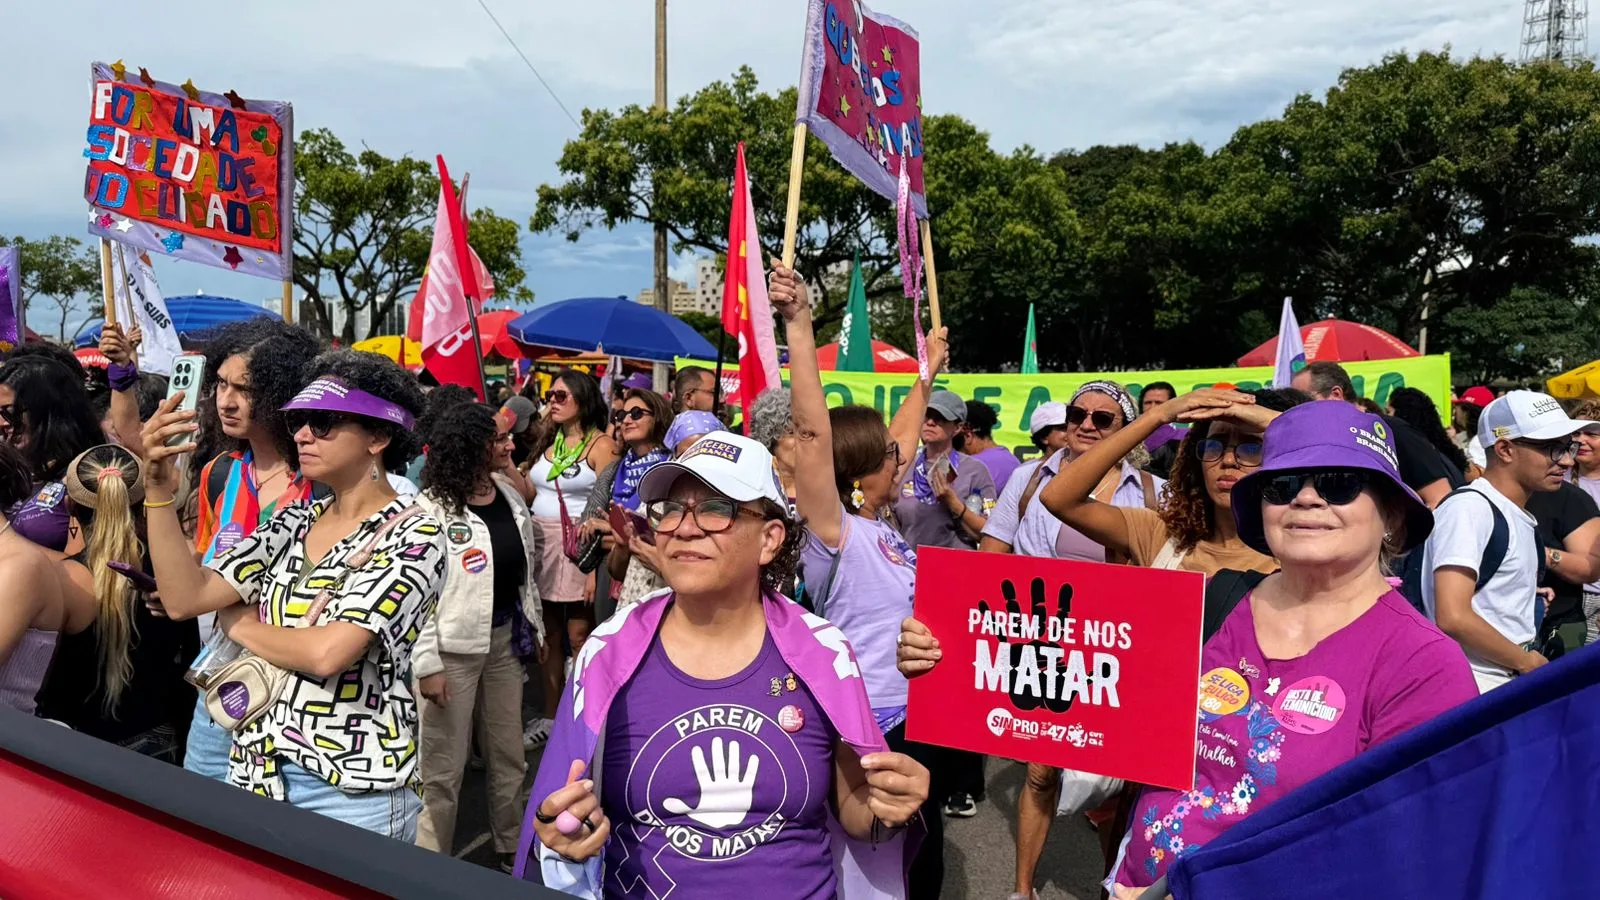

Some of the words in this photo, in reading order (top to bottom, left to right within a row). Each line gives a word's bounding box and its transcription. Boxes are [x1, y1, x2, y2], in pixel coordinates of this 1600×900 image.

[95, 82, 154, 130] POR
[173, 98, 240, 153] UMA
[83, 124, 264, 198] SOCIEDADE
[84, 165, 129, 209] DO
[135, 179, 276, 239] CUIDADO
[143, 302, 171, 330] SUAS
[1350, 426, 1358, 434] O
[968, 608, 1040, 640] PAREM
[1047, 616, 1076, 644] DE
[1083, 620, 1132, 649] NOS
[972, 639, 1121, 708] MATAR
[1207, 674, 1223, 685] SE
[1218, 678, 1244, 696] LIGA
[1204, 685, 1219, 694] EU
[1215, 689, 1239, 705] LIGO
[674, 707, 763, 738] PAREM
[991, 715, 1039, 735] SINPRO
[1199, 740, 1236, 768] Mulher
